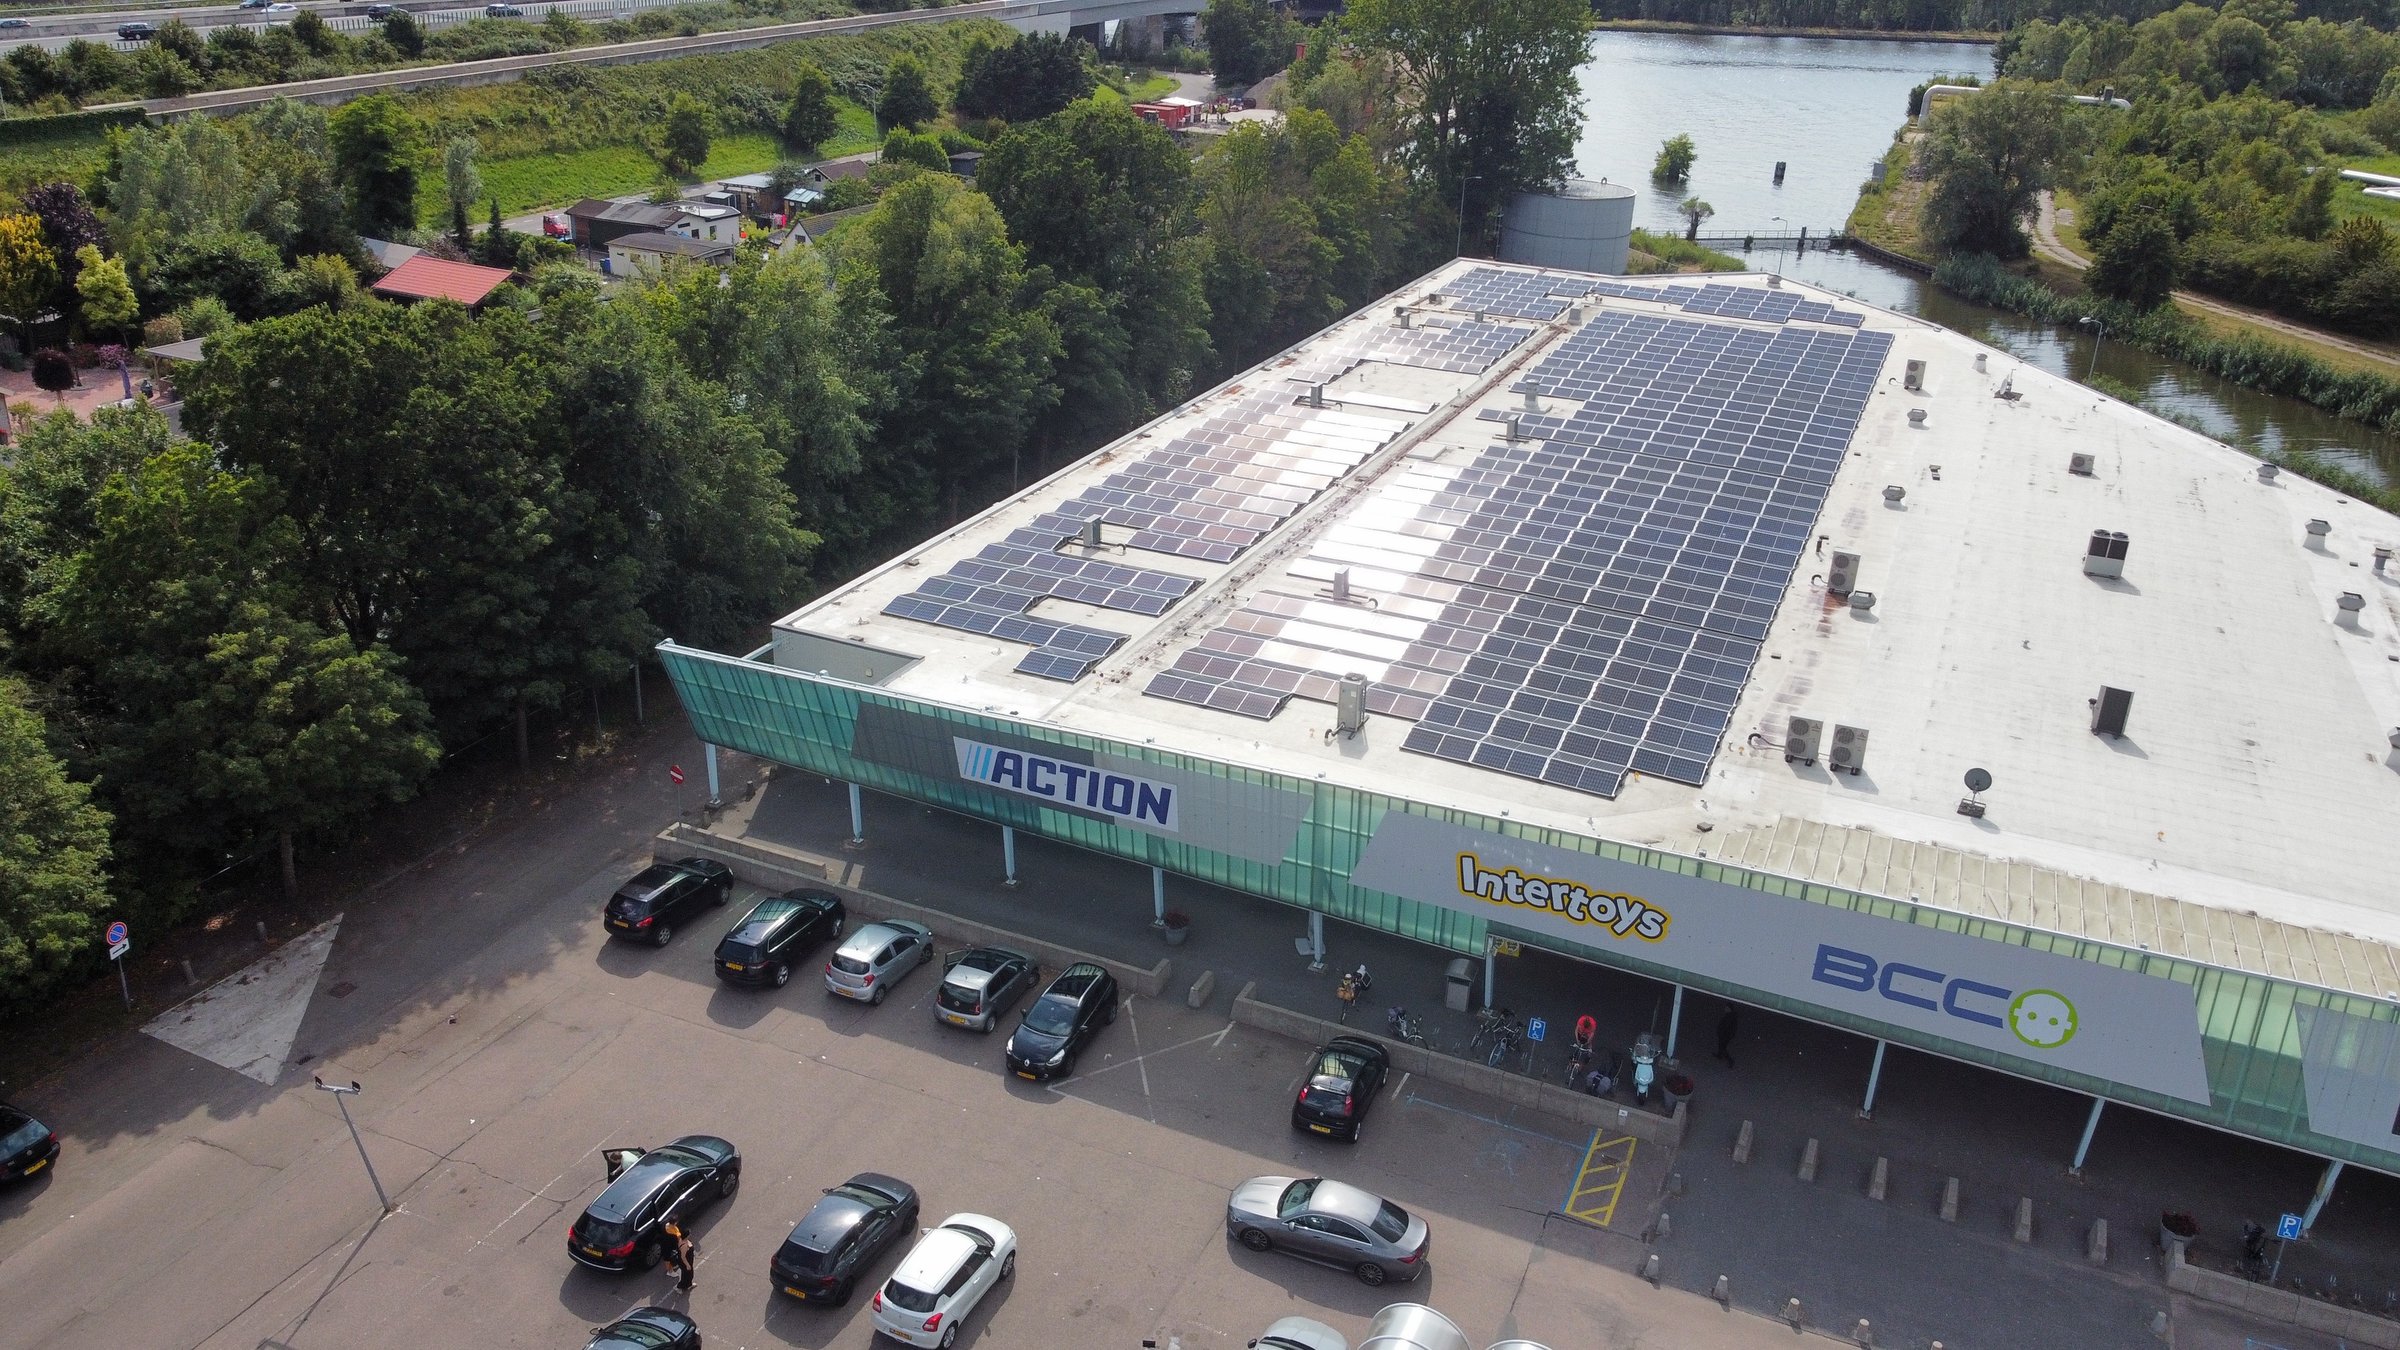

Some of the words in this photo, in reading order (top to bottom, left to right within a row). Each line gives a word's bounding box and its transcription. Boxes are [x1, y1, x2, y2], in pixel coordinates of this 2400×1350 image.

[991, 750, 1172, 825] ACTION
[1460, 855, 1667, 939] Intertoys
[1811, 943, 2013, 1029] BCC
[1532, 1020, 1542, 1031] P
[2284, 1217, 2297, 1229] P
